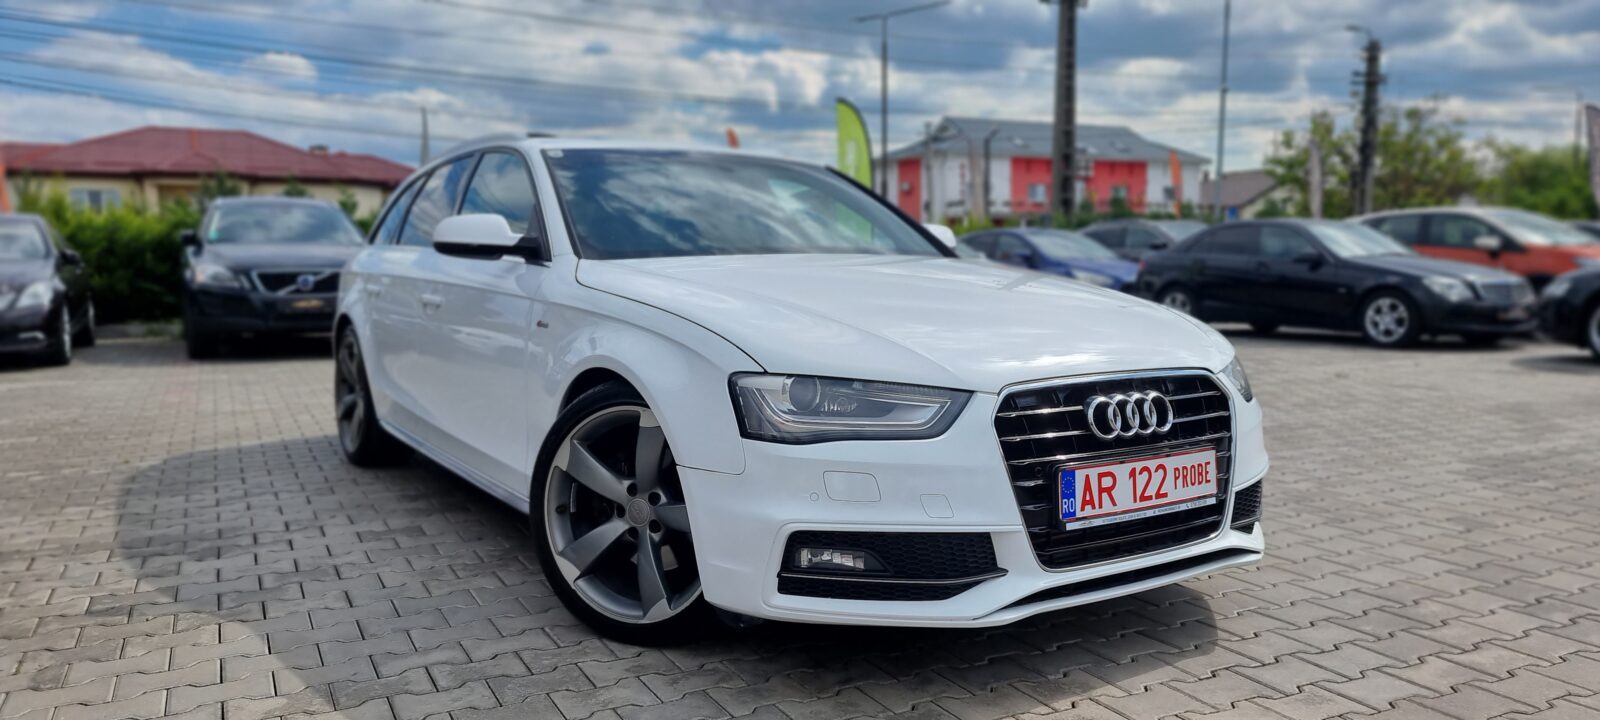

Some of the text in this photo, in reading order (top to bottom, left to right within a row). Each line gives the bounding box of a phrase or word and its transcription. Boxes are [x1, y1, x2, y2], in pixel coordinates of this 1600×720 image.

[1080, 461, 1211, 512] AR 122 PROBE
[1062, 498, 1075, 514] RO
